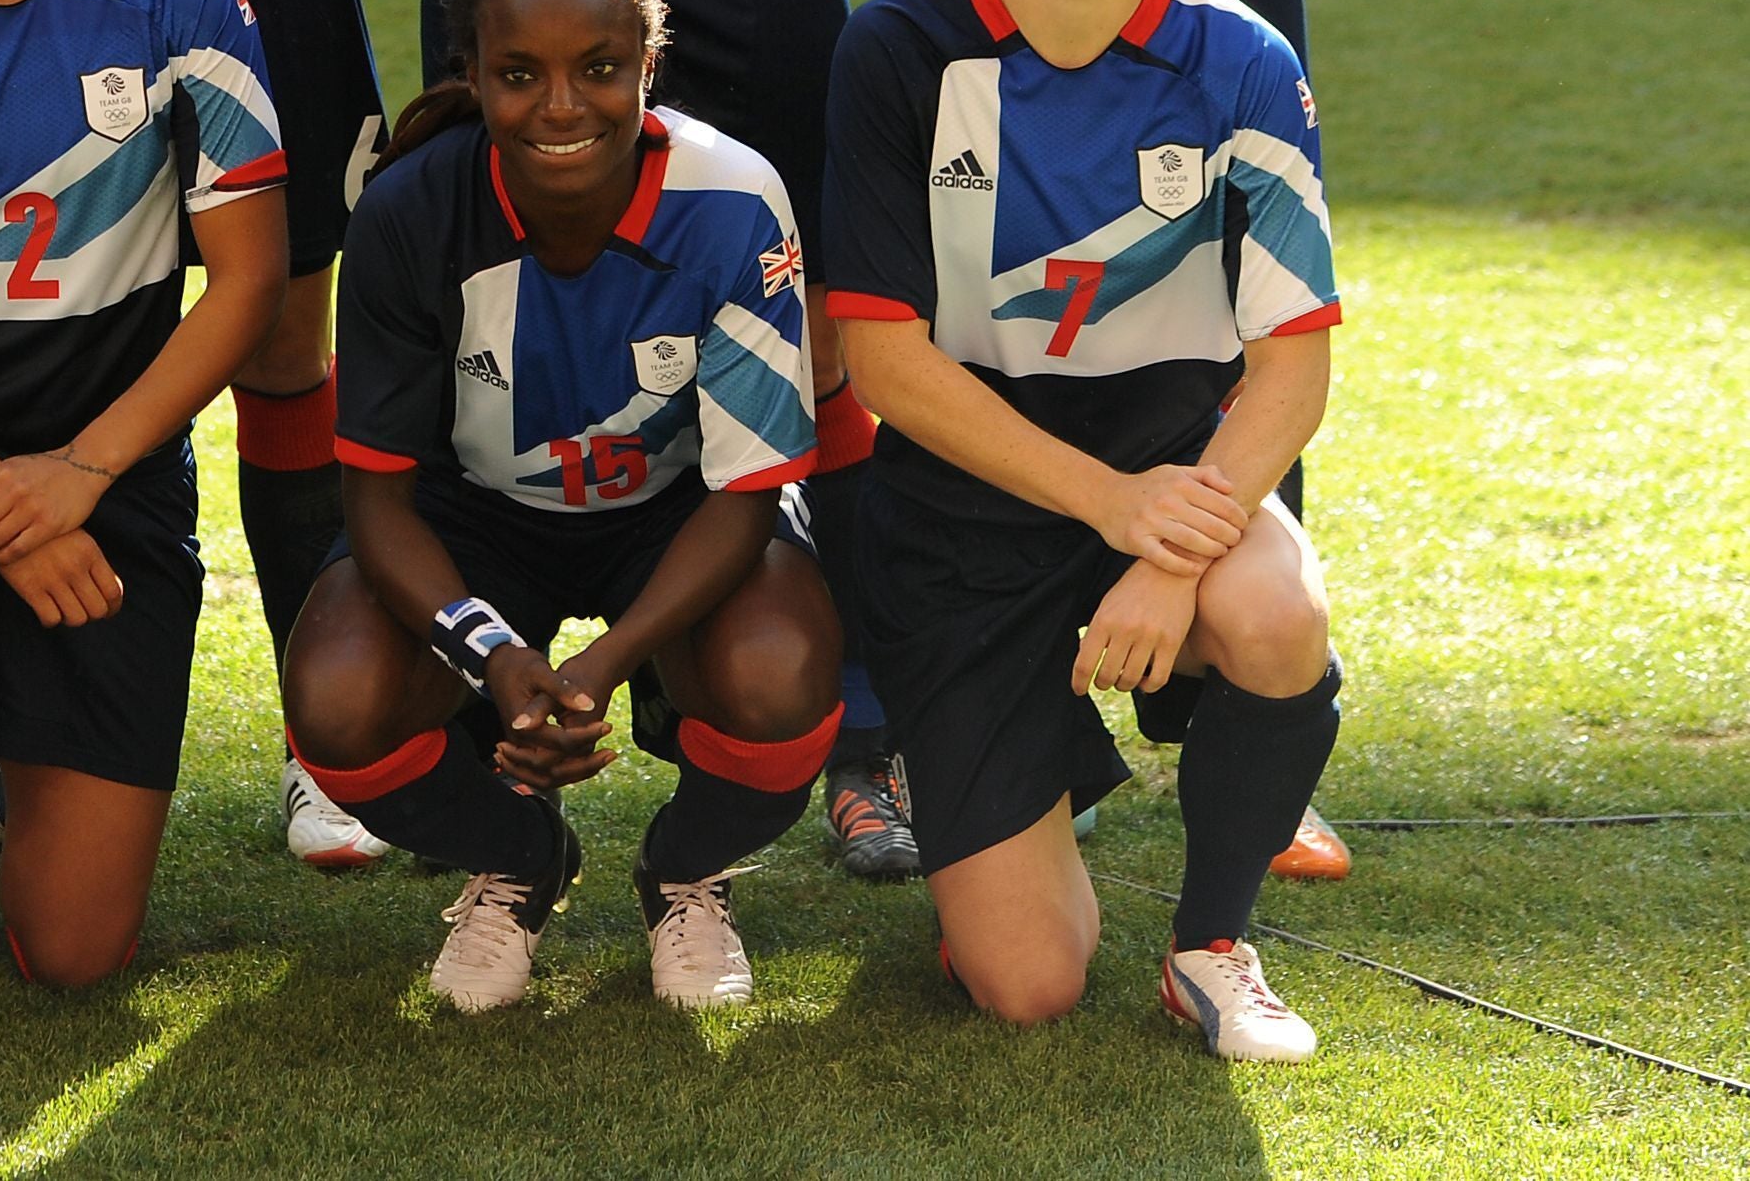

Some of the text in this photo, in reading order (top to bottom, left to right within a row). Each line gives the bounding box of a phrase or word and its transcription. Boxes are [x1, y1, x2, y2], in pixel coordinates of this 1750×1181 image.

[99, 99, 119, 107] TEAM
[931, 172, 994, 191] adidas
[1154, 175, 1175, 183] TEAM
[3, 191, 60, 299] 2
[1044, 258, 1105, 358] 7
[457, 358, 510, 391] adidas
[650, 363, 671, 371] TEAM
[549, 434, 647, 506] 15
